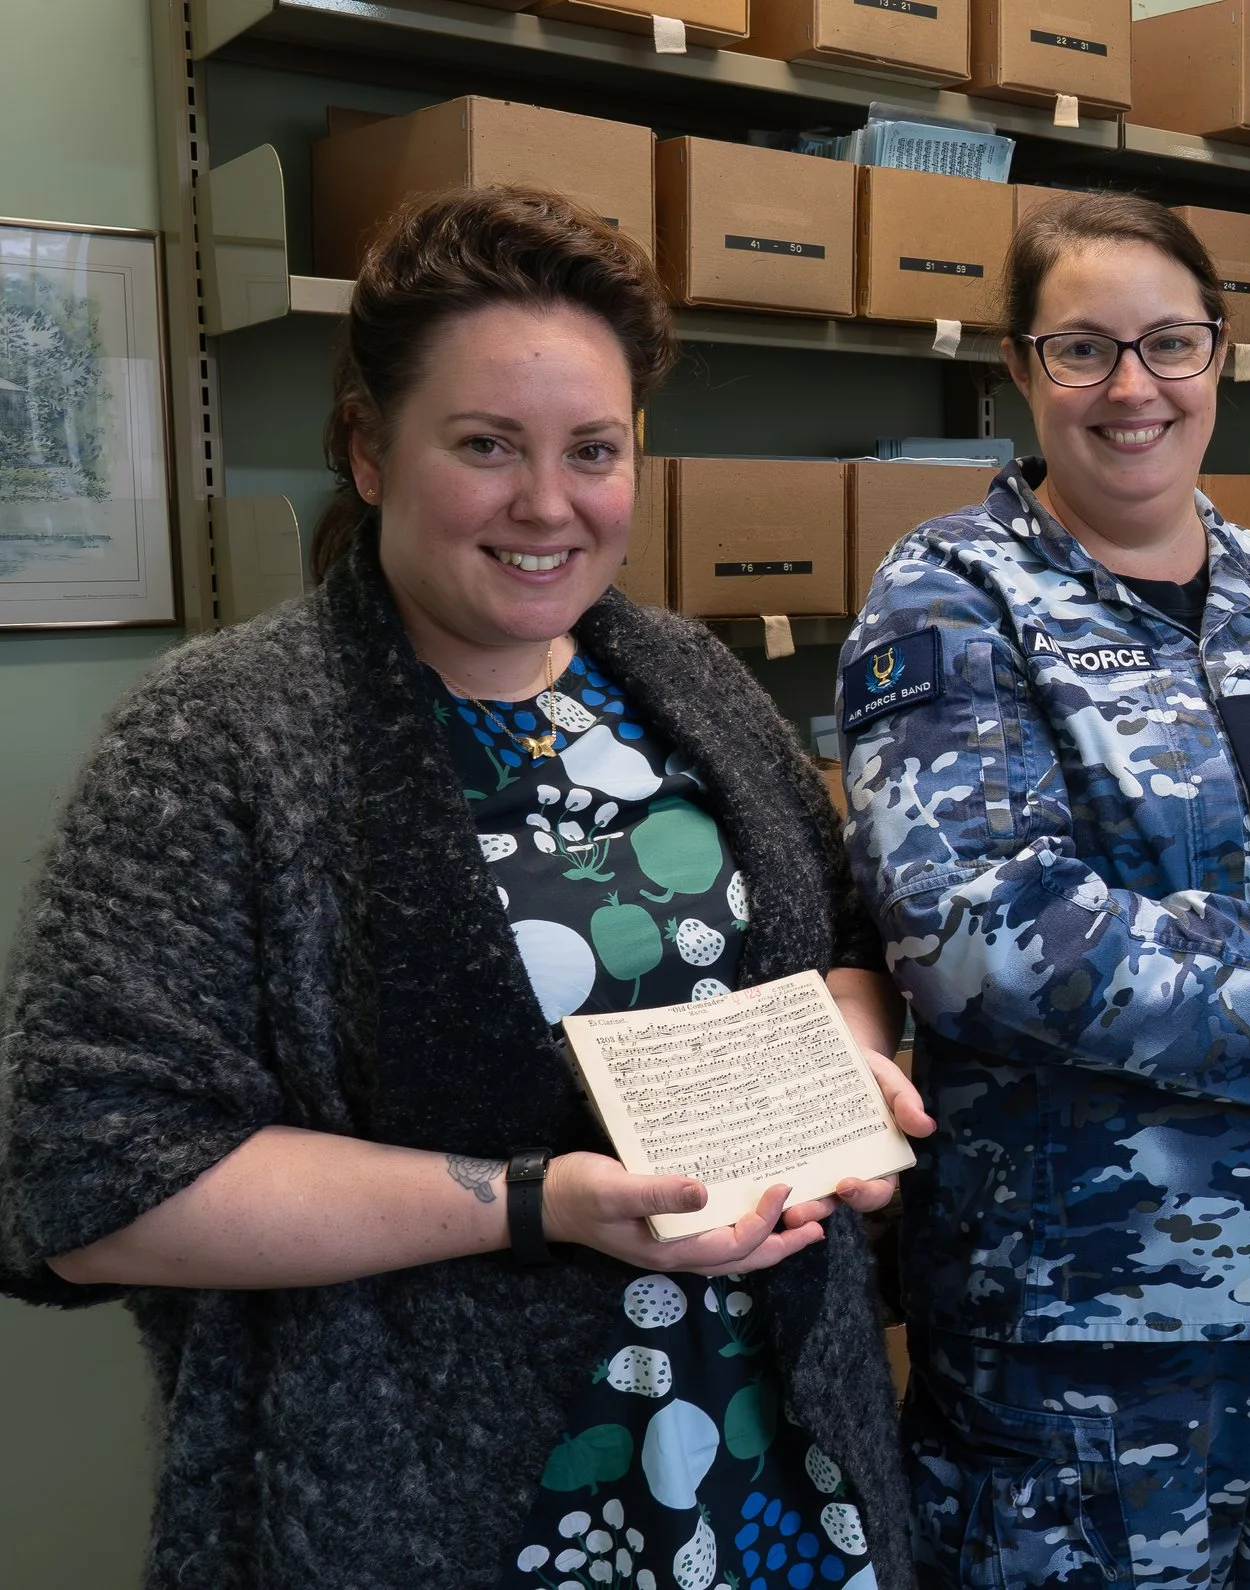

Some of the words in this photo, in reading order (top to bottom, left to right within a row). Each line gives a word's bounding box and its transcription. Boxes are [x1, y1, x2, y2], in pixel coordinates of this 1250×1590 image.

[901, 1, 911, 11] 21
[1056, 36, 1067, 44] 22
[1080, 42, 1089, 51] 31
[750, 240, 761, 249] 41
[790, 243, 803, 253] 50
[925, 262, 935, 270] 51
[956, 265, 967, 273] 59
[1223, 282, 1236, 291] 242
[740, 564, 753, 572] 76
[783, 562, 793, 571] 81
[1067, 649, 1150, 671] FORCE
[848, 709, 863, 722] AIR
[865, 692, 897, 713] FORCE
[901, 681, 931, 698] BAND
[596, 1036, 616, 1045] 1203
